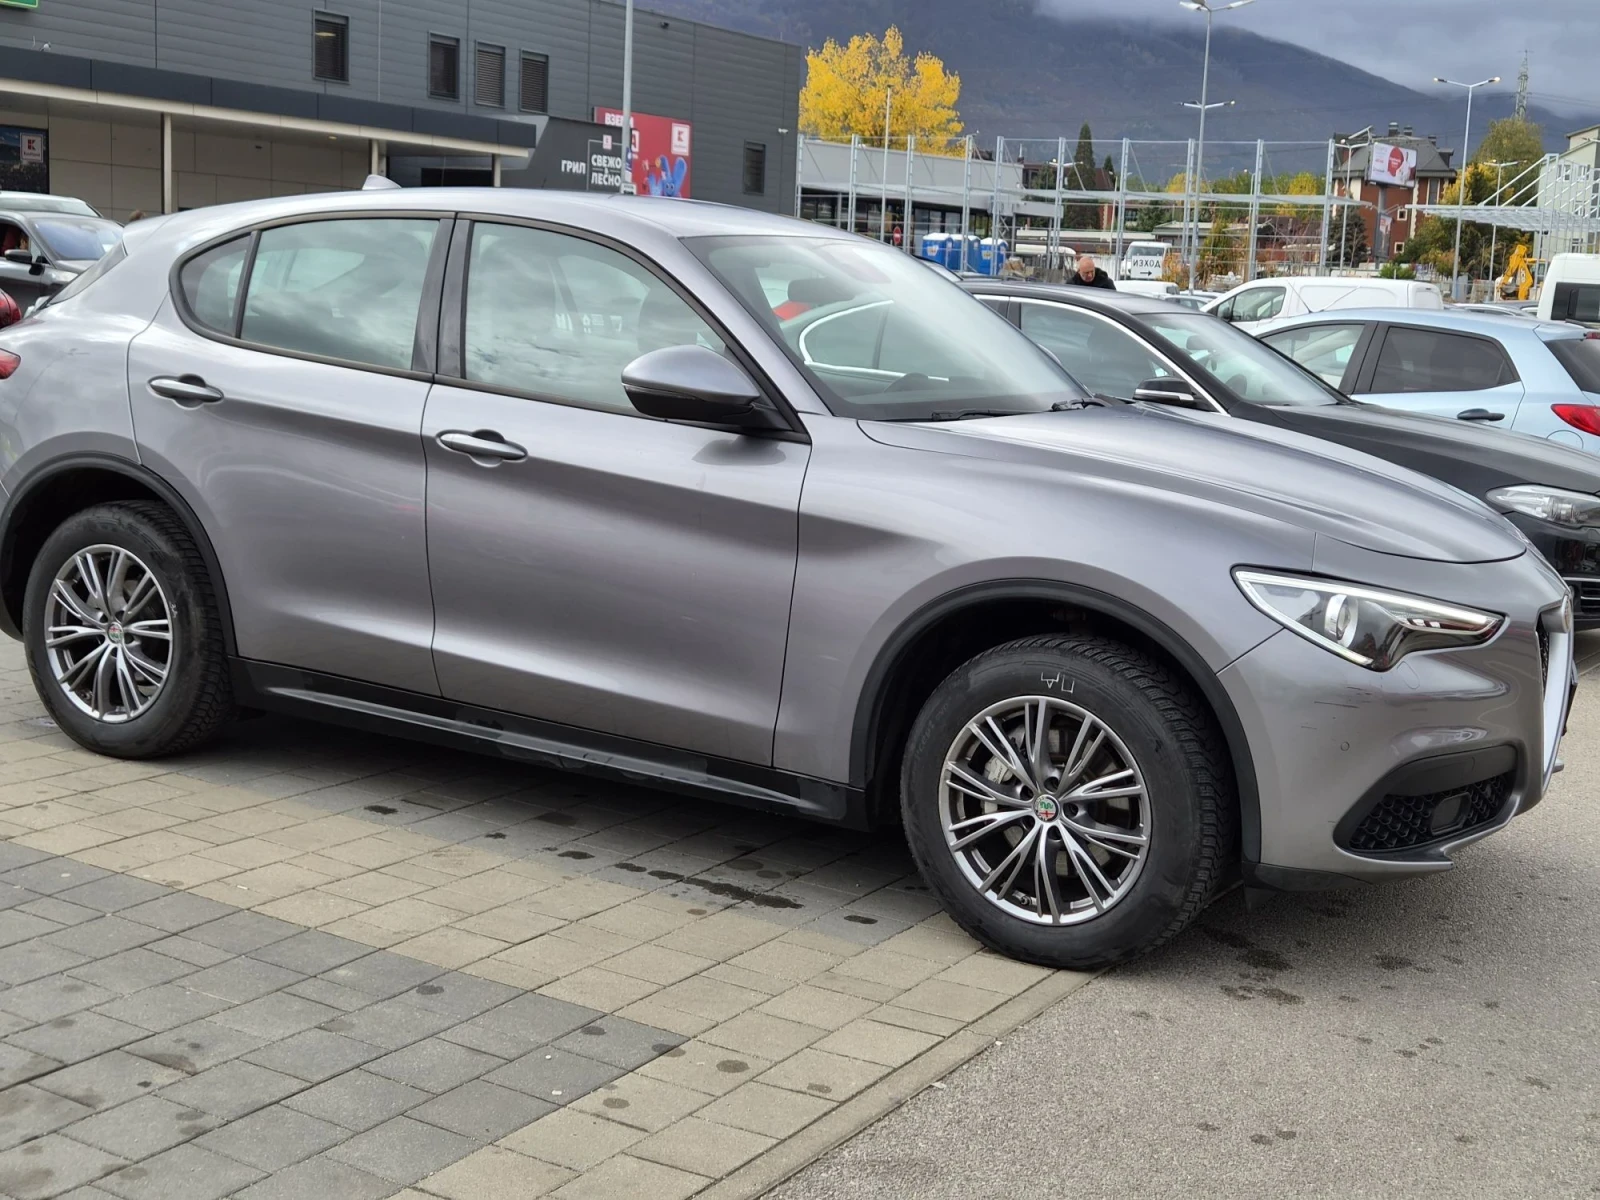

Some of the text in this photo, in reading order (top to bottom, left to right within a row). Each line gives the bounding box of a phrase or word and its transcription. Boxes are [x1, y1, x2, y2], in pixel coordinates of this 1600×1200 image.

[561, 159, 586, 175] ГРИЛ
[591, 154, 622, 169] СВЕЖО
[591, 172, 621, 187] ЛЕСНО
[1133, 259, 1161, 268] ИЗХОД
